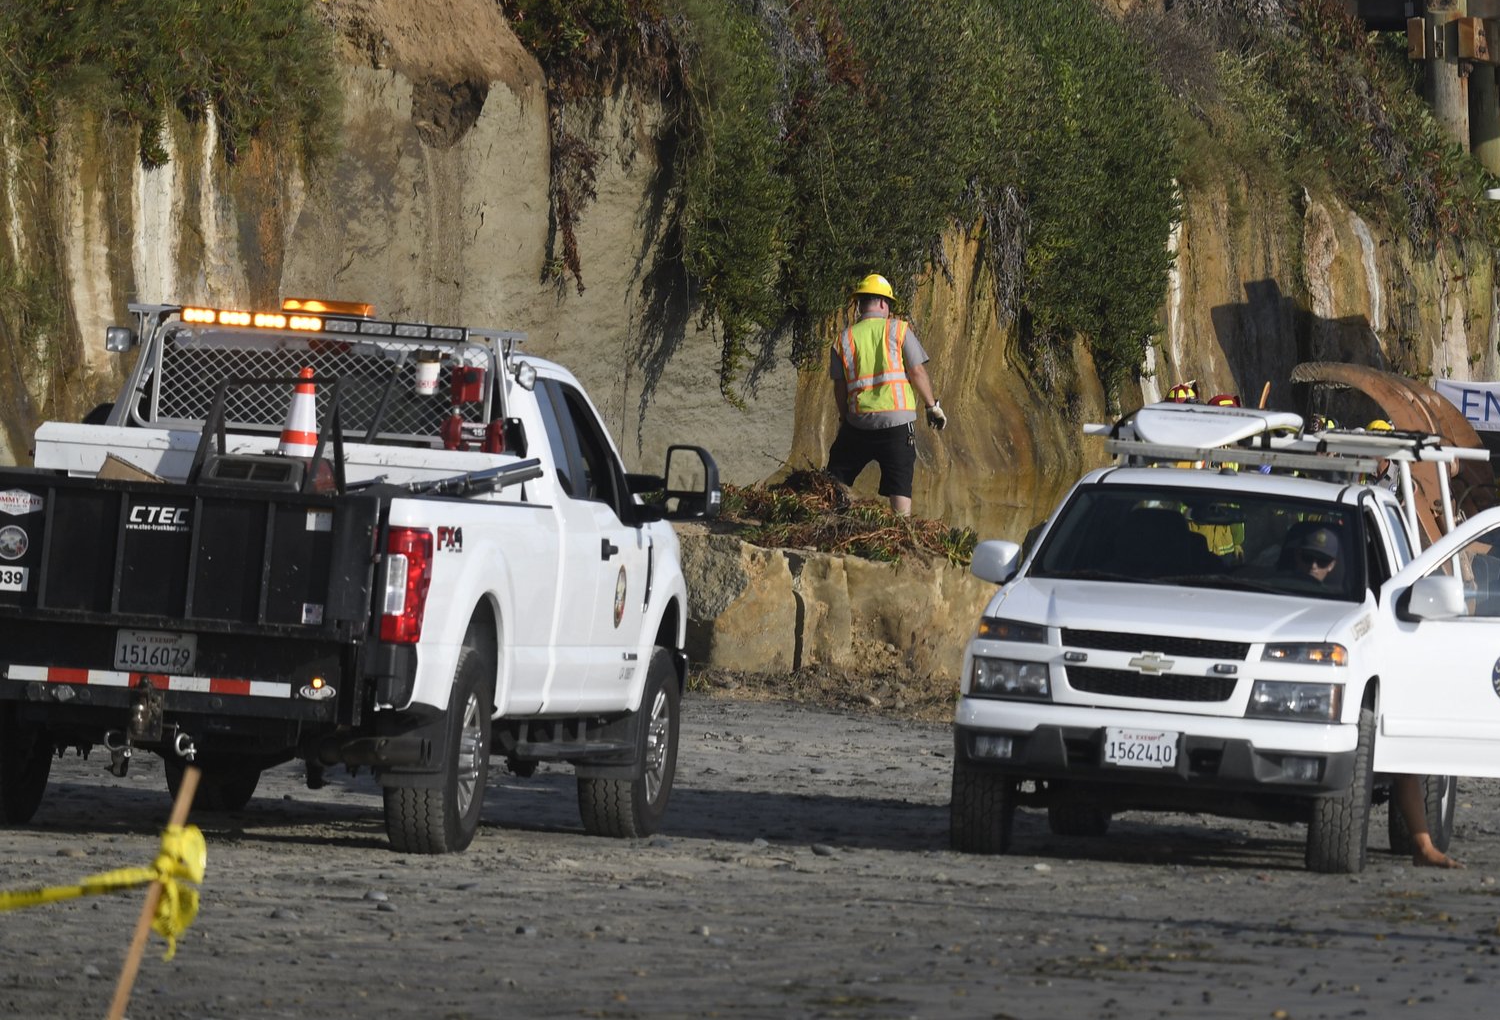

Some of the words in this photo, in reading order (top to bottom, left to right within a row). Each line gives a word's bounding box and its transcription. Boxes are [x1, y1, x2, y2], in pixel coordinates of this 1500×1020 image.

[129, 505, 190, 524] CTEC
[437, 526, 463, 551] FX4
[149, 636, 179, 644] EXEMPT
[119, 644, 191, 668] 1516079
[1108, 742, 1173, 763] 1562410
